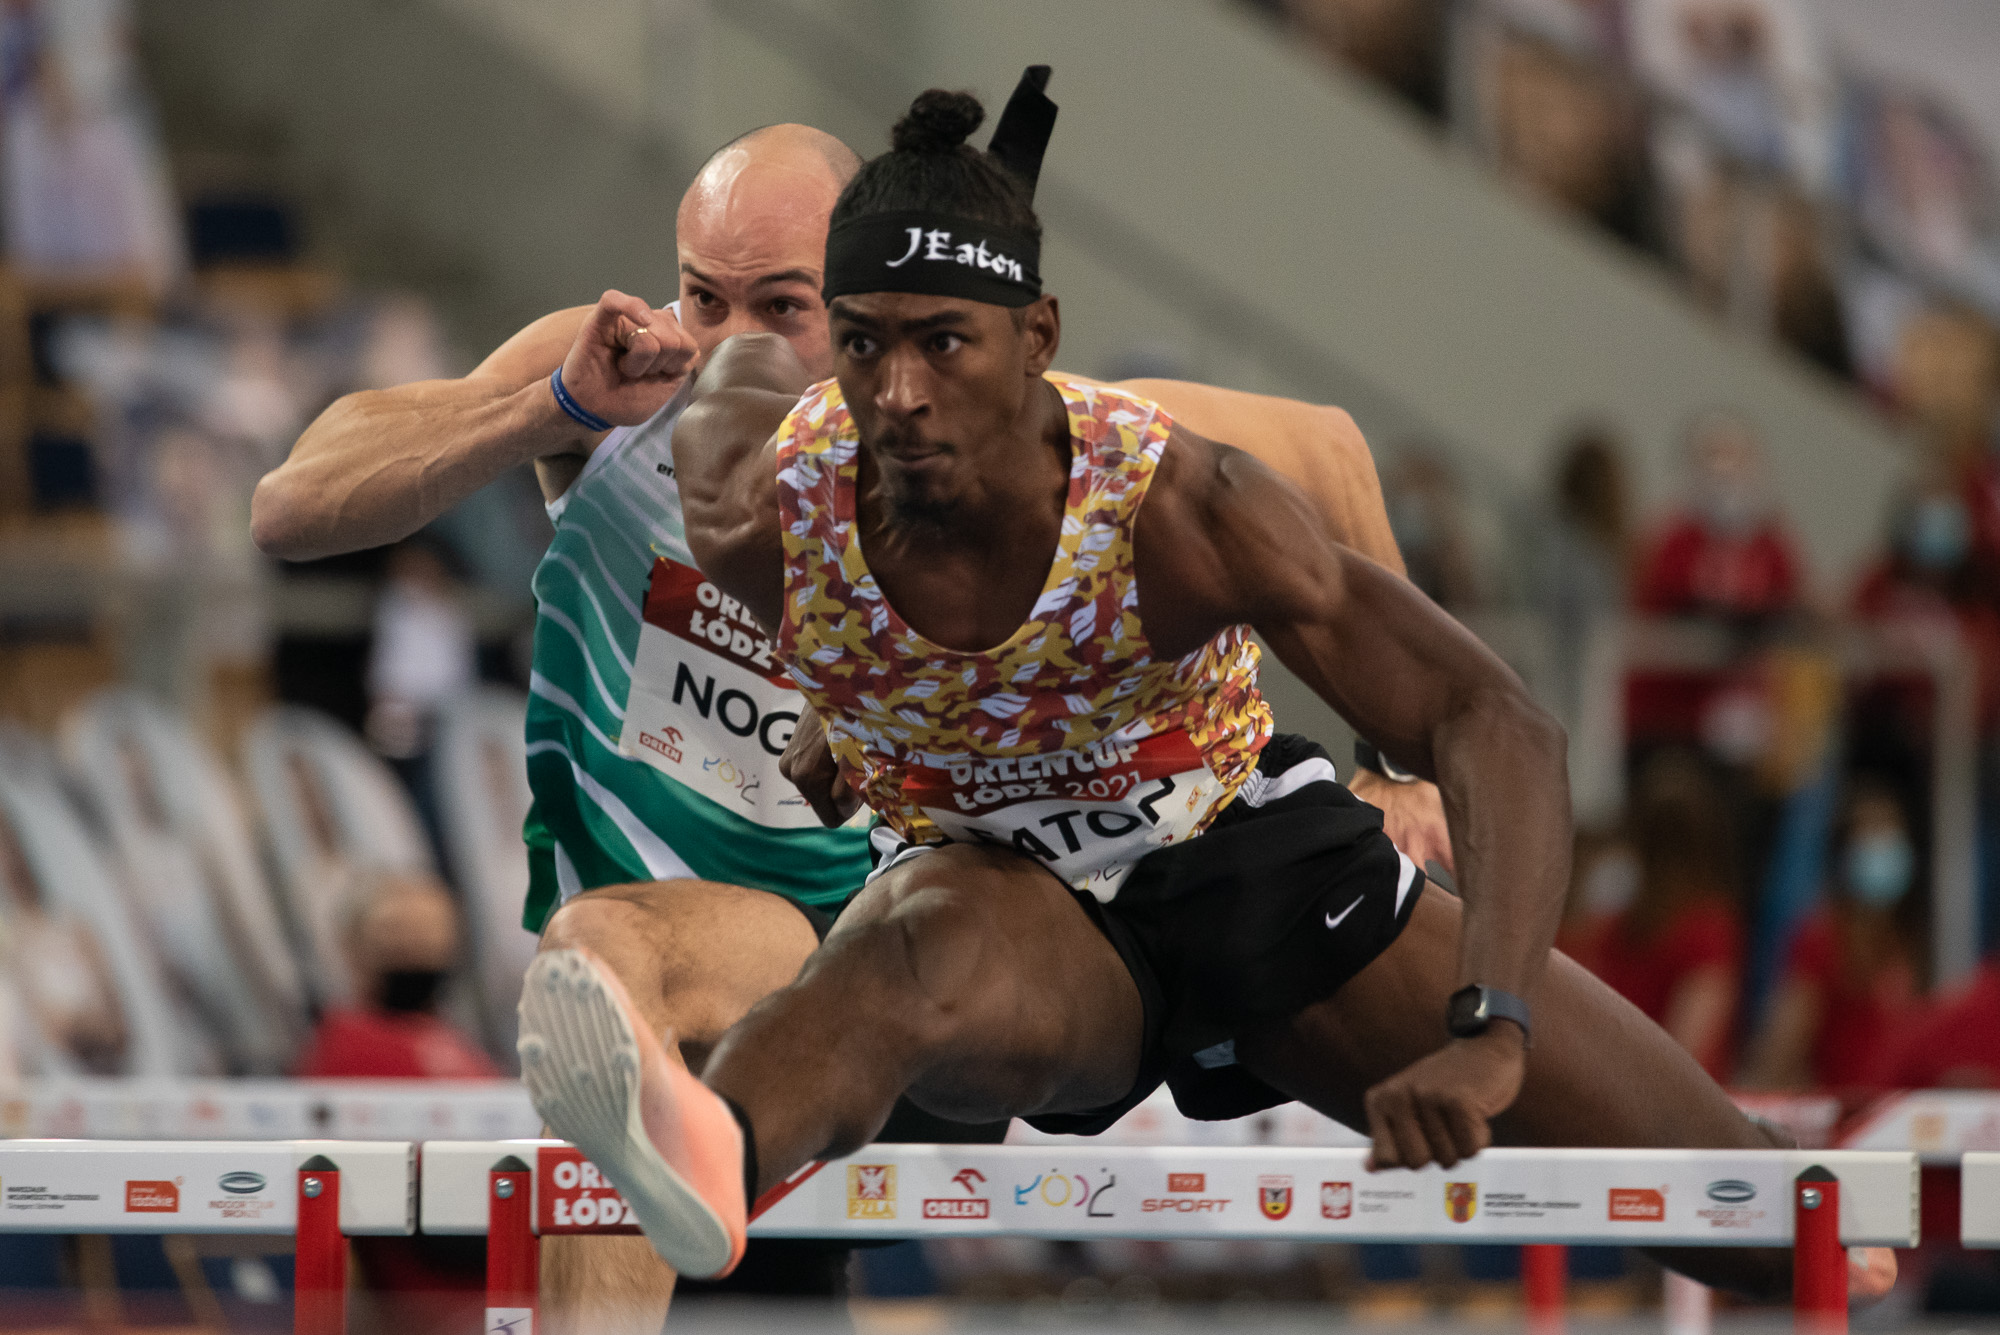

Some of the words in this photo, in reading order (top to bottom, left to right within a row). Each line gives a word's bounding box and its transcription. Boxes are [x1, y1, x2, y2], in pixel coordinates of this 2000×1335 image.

[886, 227, 1023, 282] JEaton
[696, 581, 766, 636] ORL
[671, 660, 800, 757] NOG
[925, 1201, 986, 1216] ORLEN
[1141, 1198, 1232, 1212] SPORT
